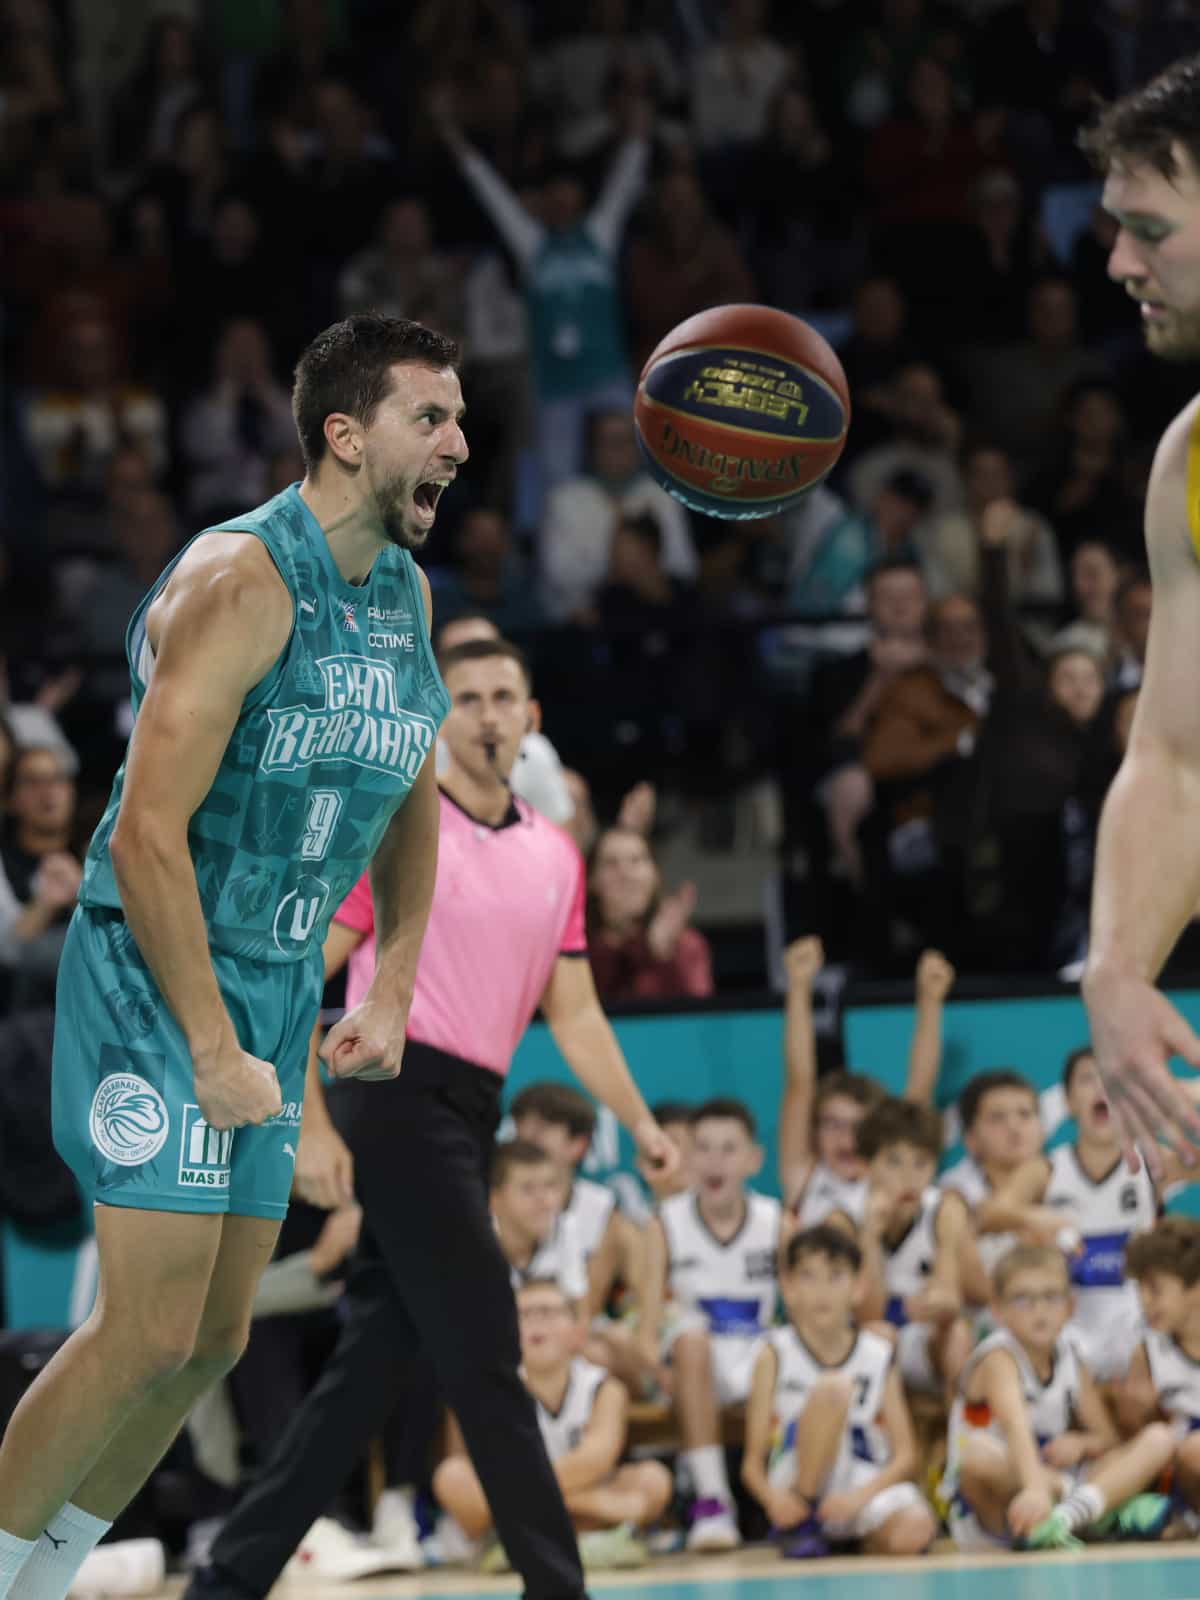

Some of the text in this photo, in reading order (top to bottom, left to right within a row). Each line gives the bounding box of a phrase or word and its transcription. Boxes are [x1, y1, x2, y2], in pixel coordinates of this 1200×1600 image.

[683, 379, 809, 426] LEGACY
[661, 418, 808, 480] SPALDING
[368, 633, 415, 649] OCTIME
[302, 789, 343, 862] 9
[181, 1171, 215, 1184] MAS
